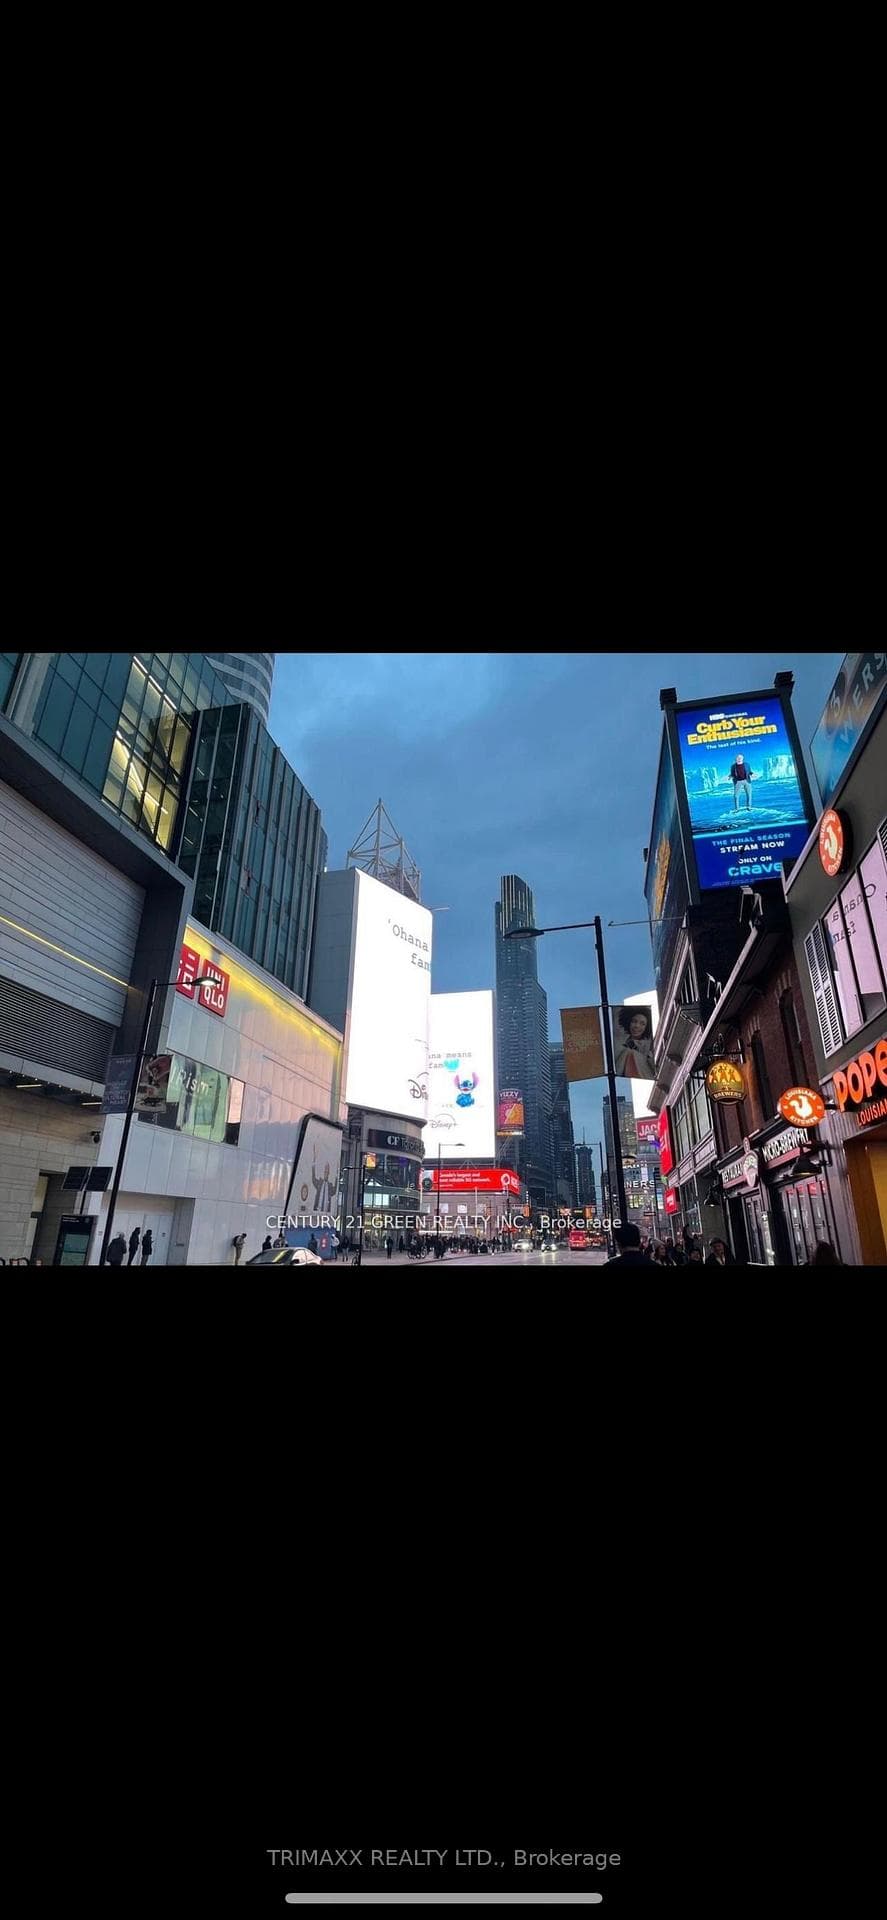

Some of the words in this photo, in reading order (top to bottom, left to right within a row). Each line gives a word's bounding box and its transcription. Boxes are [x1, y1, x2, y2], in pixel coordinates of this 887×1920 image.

[696, 720, 734, 734] Curb
[731, 716, 766, 730] Your
[687, 724, 778, 746] Enthusiasm
[730, 836, 755, 844] FINAL
[756, 832, 792, 841] SEASON
[761, 840, 785, 849] NOW
[738, 856, 758, 864] ONLY
[204, 985, 225, 1009] QLO
[713, 1091, 742, 1099] BREWERS
[784, 1088, 817, 1101] LOUISIANA
[387, 1135, 400, 1146] CF
